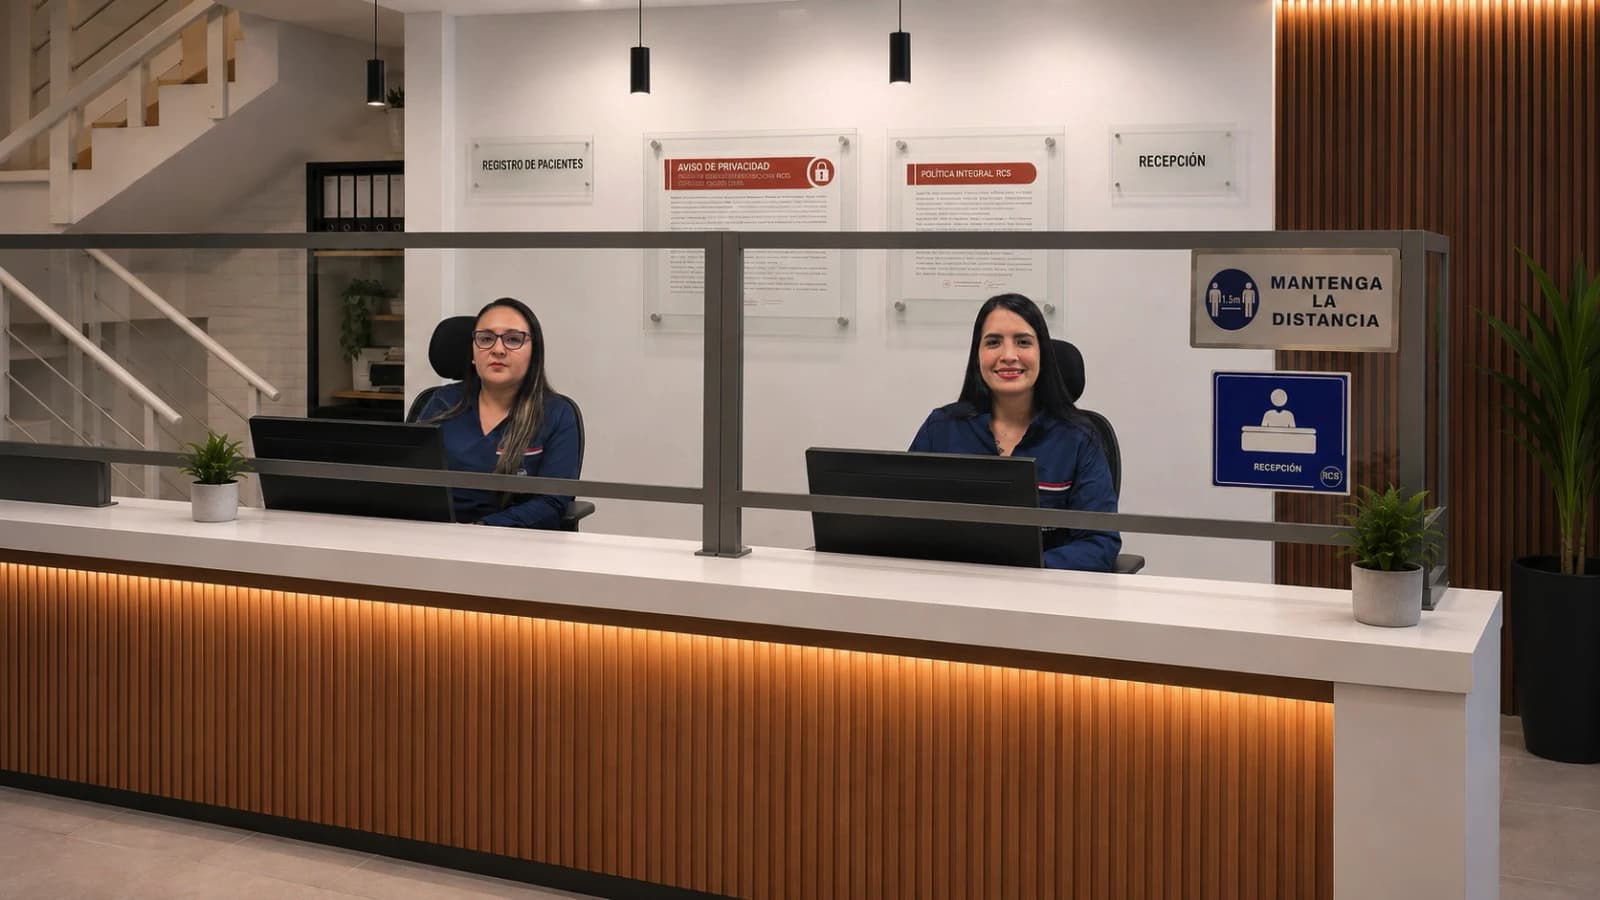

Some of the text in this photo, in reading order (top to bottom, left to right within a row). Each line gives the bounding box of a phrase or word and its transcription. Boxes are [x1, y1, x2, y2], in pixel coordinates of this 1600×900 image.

[482, 158, 584, 171] REGISTRO DE PACIENTES
[1139, 152, 1206, 168] RECEPCIÓN
[678, 161, 770, 172] AVISO DE PRIVACIDAD
[921, 168, 1012, 178] POLÍTICA INTEGRAL RCS
[1271, 276, 1383, 290] MANTENGA
[1222, 295, 1241, 304] 1.5m
[1312, 294, 1336, 308] LA
[1272, 312, 1380, 327] DISTANCIA
[1253, 463, 1302, 473] RECEPCIÓN
[1322, 471, 1340, 480] RCS
